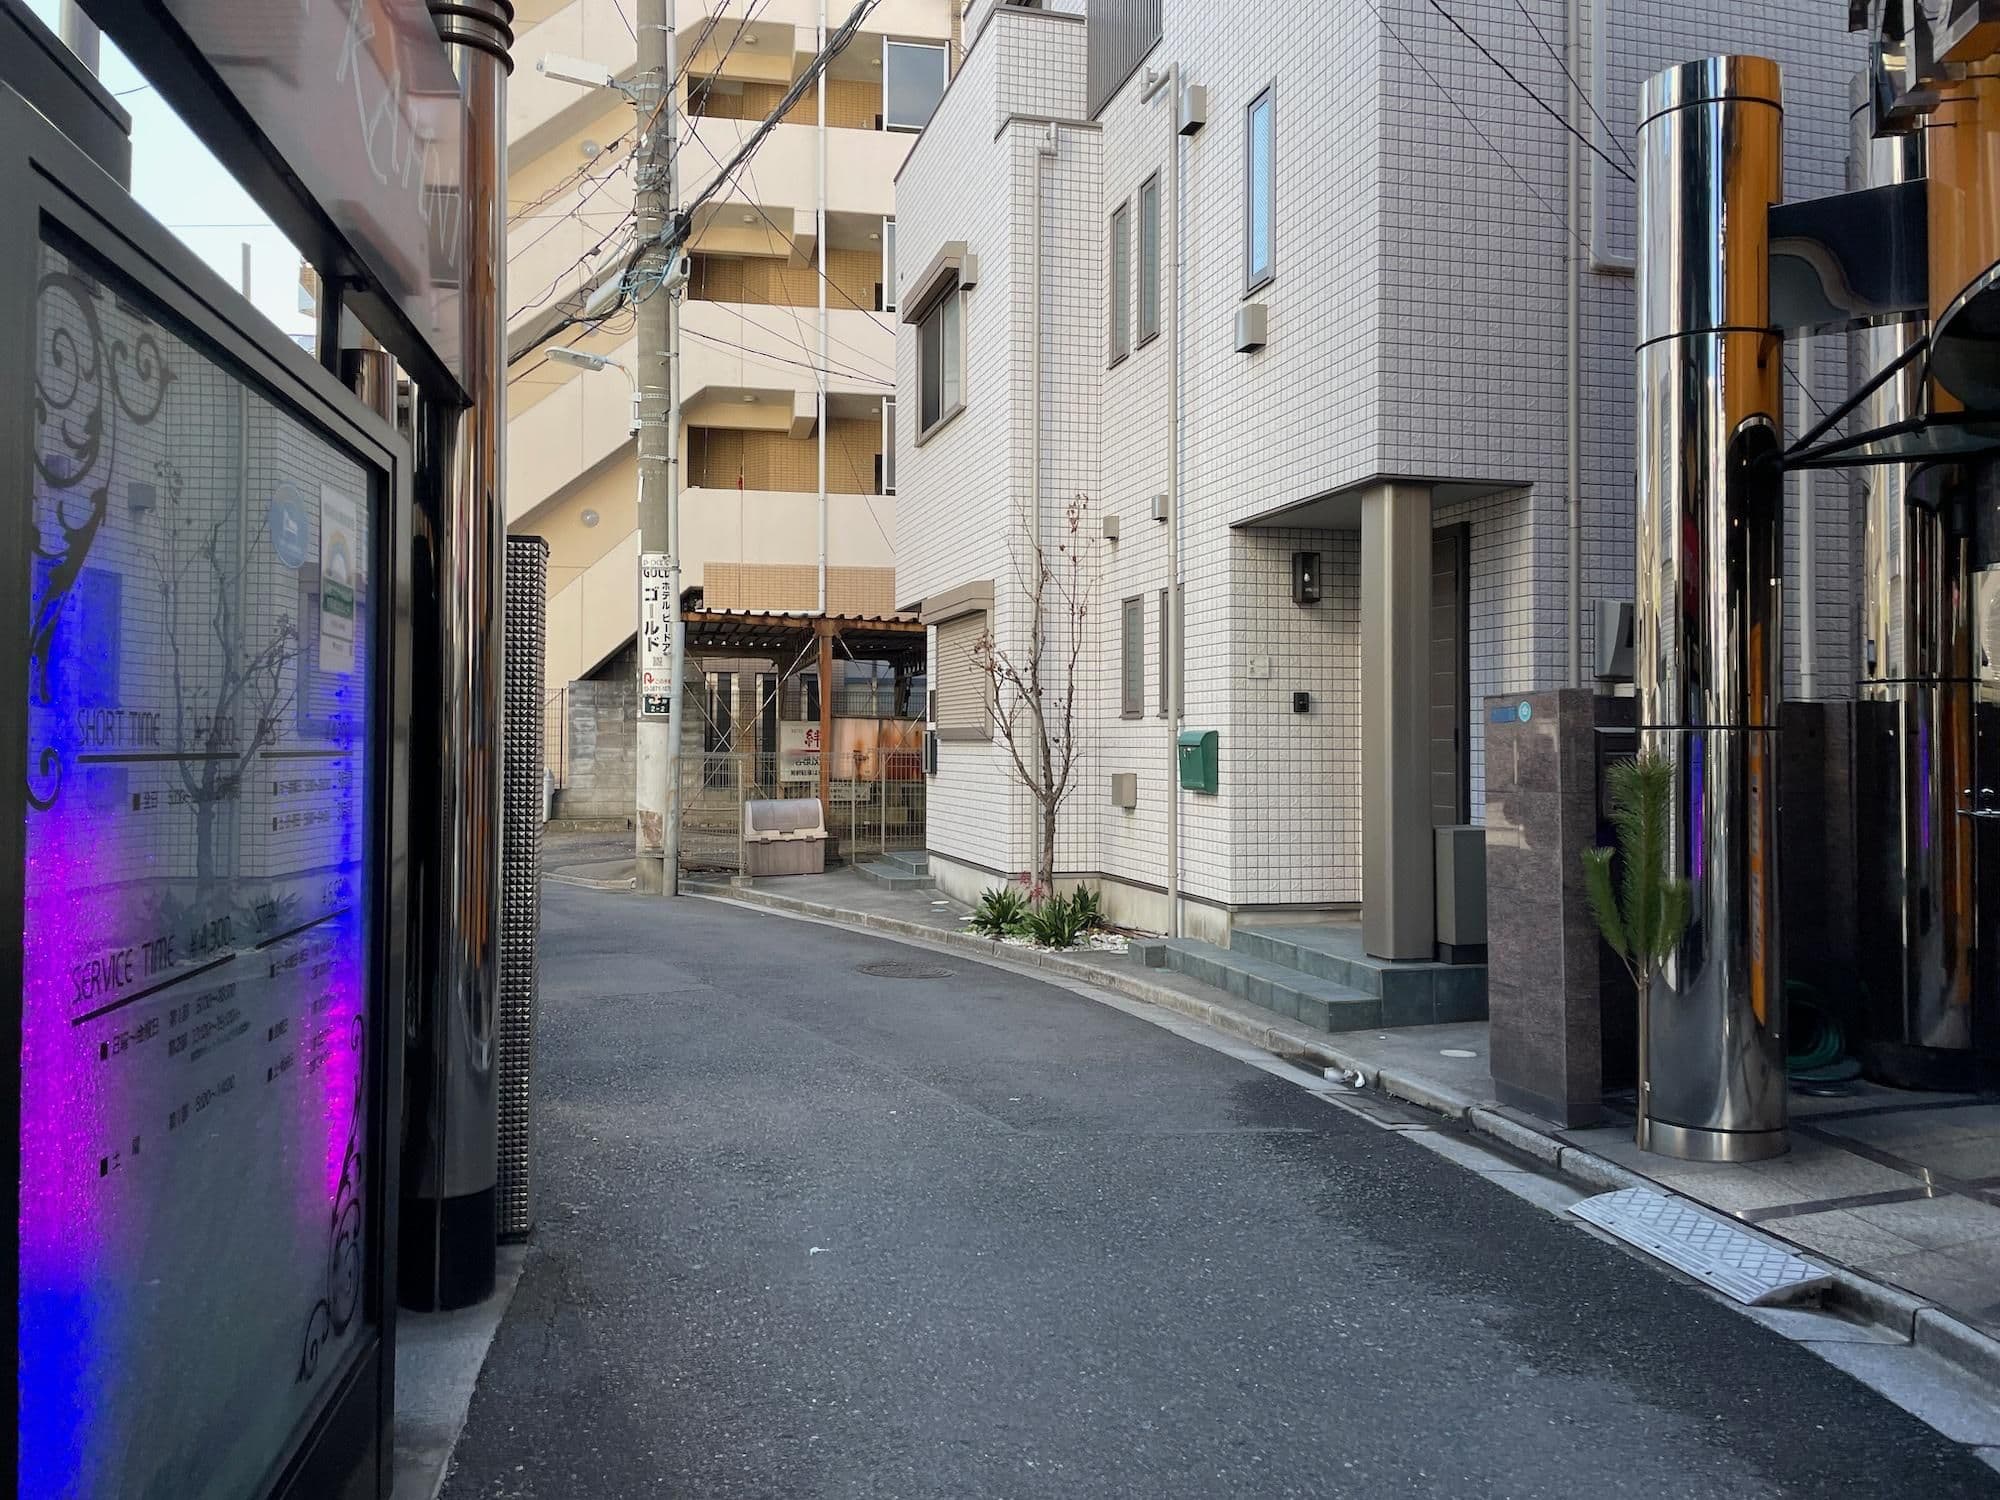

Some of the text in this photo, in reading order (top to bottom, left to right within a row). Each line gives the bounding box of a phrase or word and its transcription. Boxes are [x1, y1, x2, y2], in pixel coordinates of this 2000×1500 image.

[645, 585, 660, 653] ゴールド
[77, 708, 125, 746] SHORT
[128, 711, 160, 746] TIME
[71, 948, 133, 1006] SERVICE
[141, 934, 176, 977] TIME
